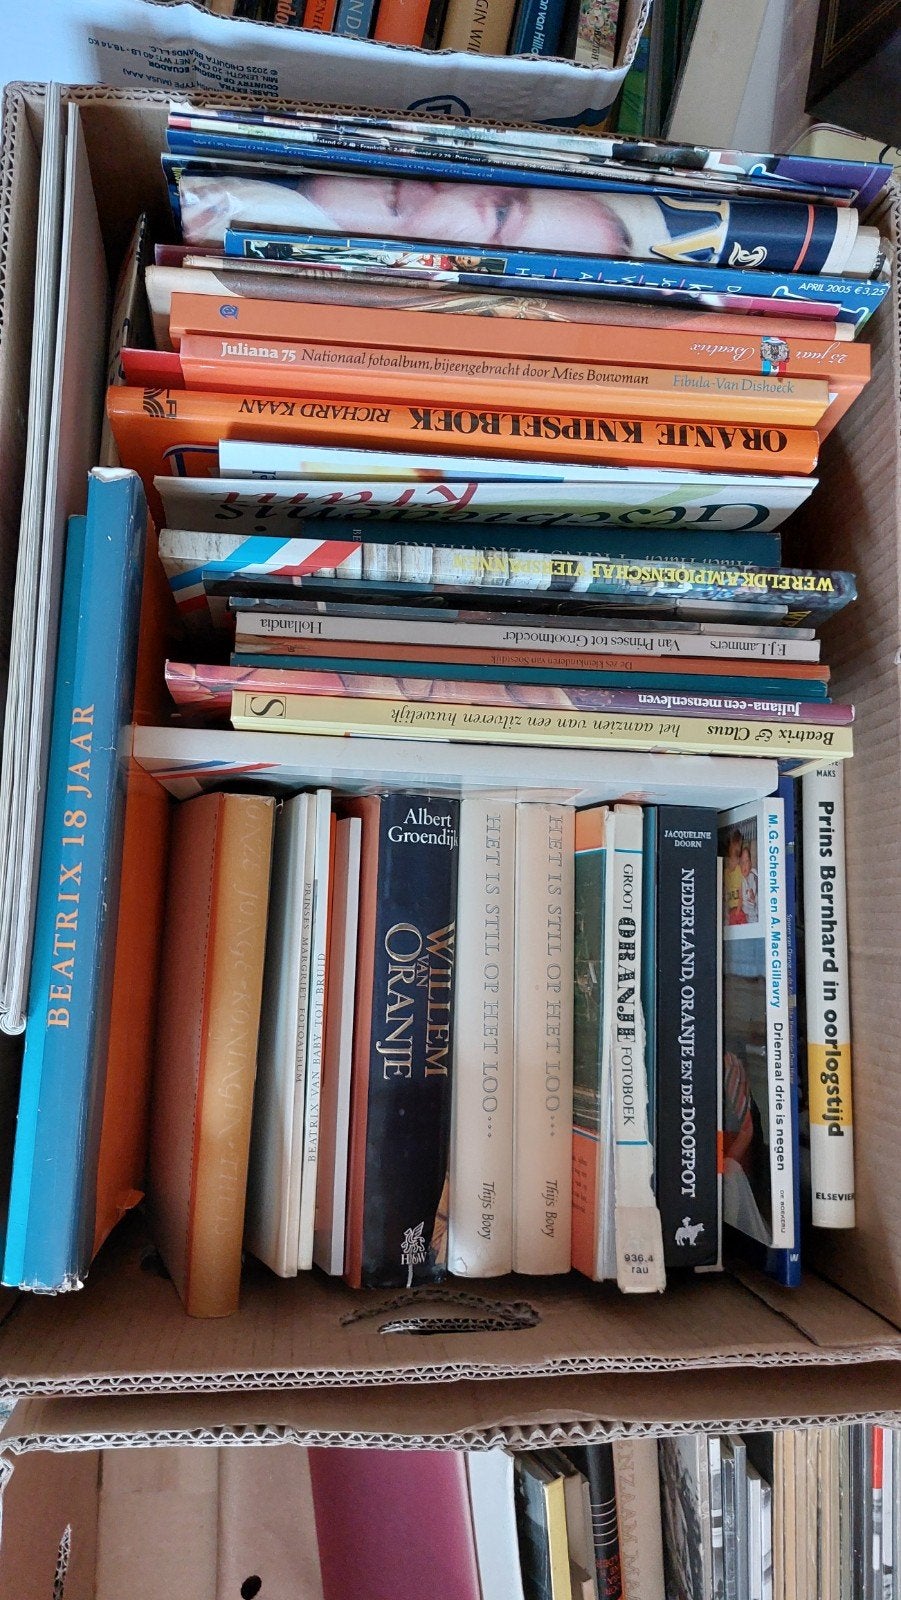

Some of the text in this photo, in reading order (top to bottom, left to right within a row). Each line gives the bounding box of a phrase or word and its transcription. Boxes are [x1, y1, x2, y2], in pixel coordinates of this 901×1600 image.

[534, 11, 546, 31] van
[88, 37, 99, 47] KG
[131, 48, 141, 57] LB
[143, 52, 154, 60] 40
[172, 48, 204, 60] BRANDS
[173, 56, 190, 66] NET
[148, 60, 190, 73] ECUADOR
[205, 54, 244, 72] CHIQUITA
[211, 66, 223, 75] 20
[223, 74, 235, 86] OF
[236, 77, 278, 91] COUNTRY
[260, 73, 278, 83] MIN.
[798, 282, 825, 293] APRIL
[826, 285, 851, 294] 2005
[690, 342, 849, 364] 25 jaar Beatrix
[220, 342, 278, 359] Juliana
[281, 349, 296, 362] 75
[301, 348, 366, 365] Nationaal
[522, 363, 550, 378] door
[551, 366, 584, 380] Mies
[586, 370, 648, 385] Bouwman
[238, 398, 788, 453] ORANJE KNIPSELBOEK RICHARD KAAN
[453, 552, 585, 578] VIERSPANNEN
[591, 562, 835, 593] WERELDKAMPIOENSCHAP
[259, 617, 324, 634] Hollandia
[503, 630, 588, 648] Grootmoeder
[591, 635, 608, 649] tot
[611, 636, 654, 651] Prinses
[657, 637, 680, 652] Van
[710, 639, 766, 655] Lammers
[491, 655, 529, 667] Soestdijk
[531, 656, 546, 666] van
[621, 660, 633, 671] De
[638, 693, 723, 710] mensenleven
[390, 704, 834, 746] Beatrix & Claus het aanzien van een zilveren huwelijk
[816, 769, 836, 778] MAKS
[403, 807, 453, 828] Albert
[768, 813, 779, 828] M.
[388, 826, 459, 851] Groendijk
[485, 814, 501, 867] HET
[548, 815, 564, 868] HET
[664, 829, 712, 840] JACQUELINE
[674, 839, 702, 849] DOORN
[47, 703, 95, 1028] BEATRIX 18 JAAR
[485, 873, 500, 896] IS
[547, 874, 562, 896] IS
[770, 897, 778, 913] en
[484, 903, 500, 957] STIL
[546, 903, 562, 957] STIL
[770, 915, 781, 929] A.
[416, 955, 429, 988] VAN
[483, 963, 499, 994] OP
[546, 963, 562, 994] OP
[818, 801, 844, 1137] Prins Bernhard in oorlogstijd
[295, 883, 312, 1083] PRINSES MARGRIET FOTOALBUM
[376, 922, 423, 1081] ORANJE
[424, 920, 456, 1078] WILLEM
[617, 863, 636, 1127] GROOT ORANJE FOTOBOEK
[482, 1000, 499, 1054] HET
[546, 1000, 562, 1054] HET
[677, 868, 697, 1198] NEDERLAND, ORANJE EN DE DOOFPOT
[307, 953, 326, 1163] BEATRIX VAN BABY TOT BRUID
[773, 1022, 783, 1081] Driemaal
[774, 1083, 783, 1111] drie
[775, 1114, 783, 1126] is
[773, 1128, 785, 1172] negen
[477, 1181, 495, 1241] Thijs Booy
[541, 1179, 558, 1239] Thijs Booy
[624, 1253, 654, 1263] 936.4
[631, 1264, 649, 1275] rau
